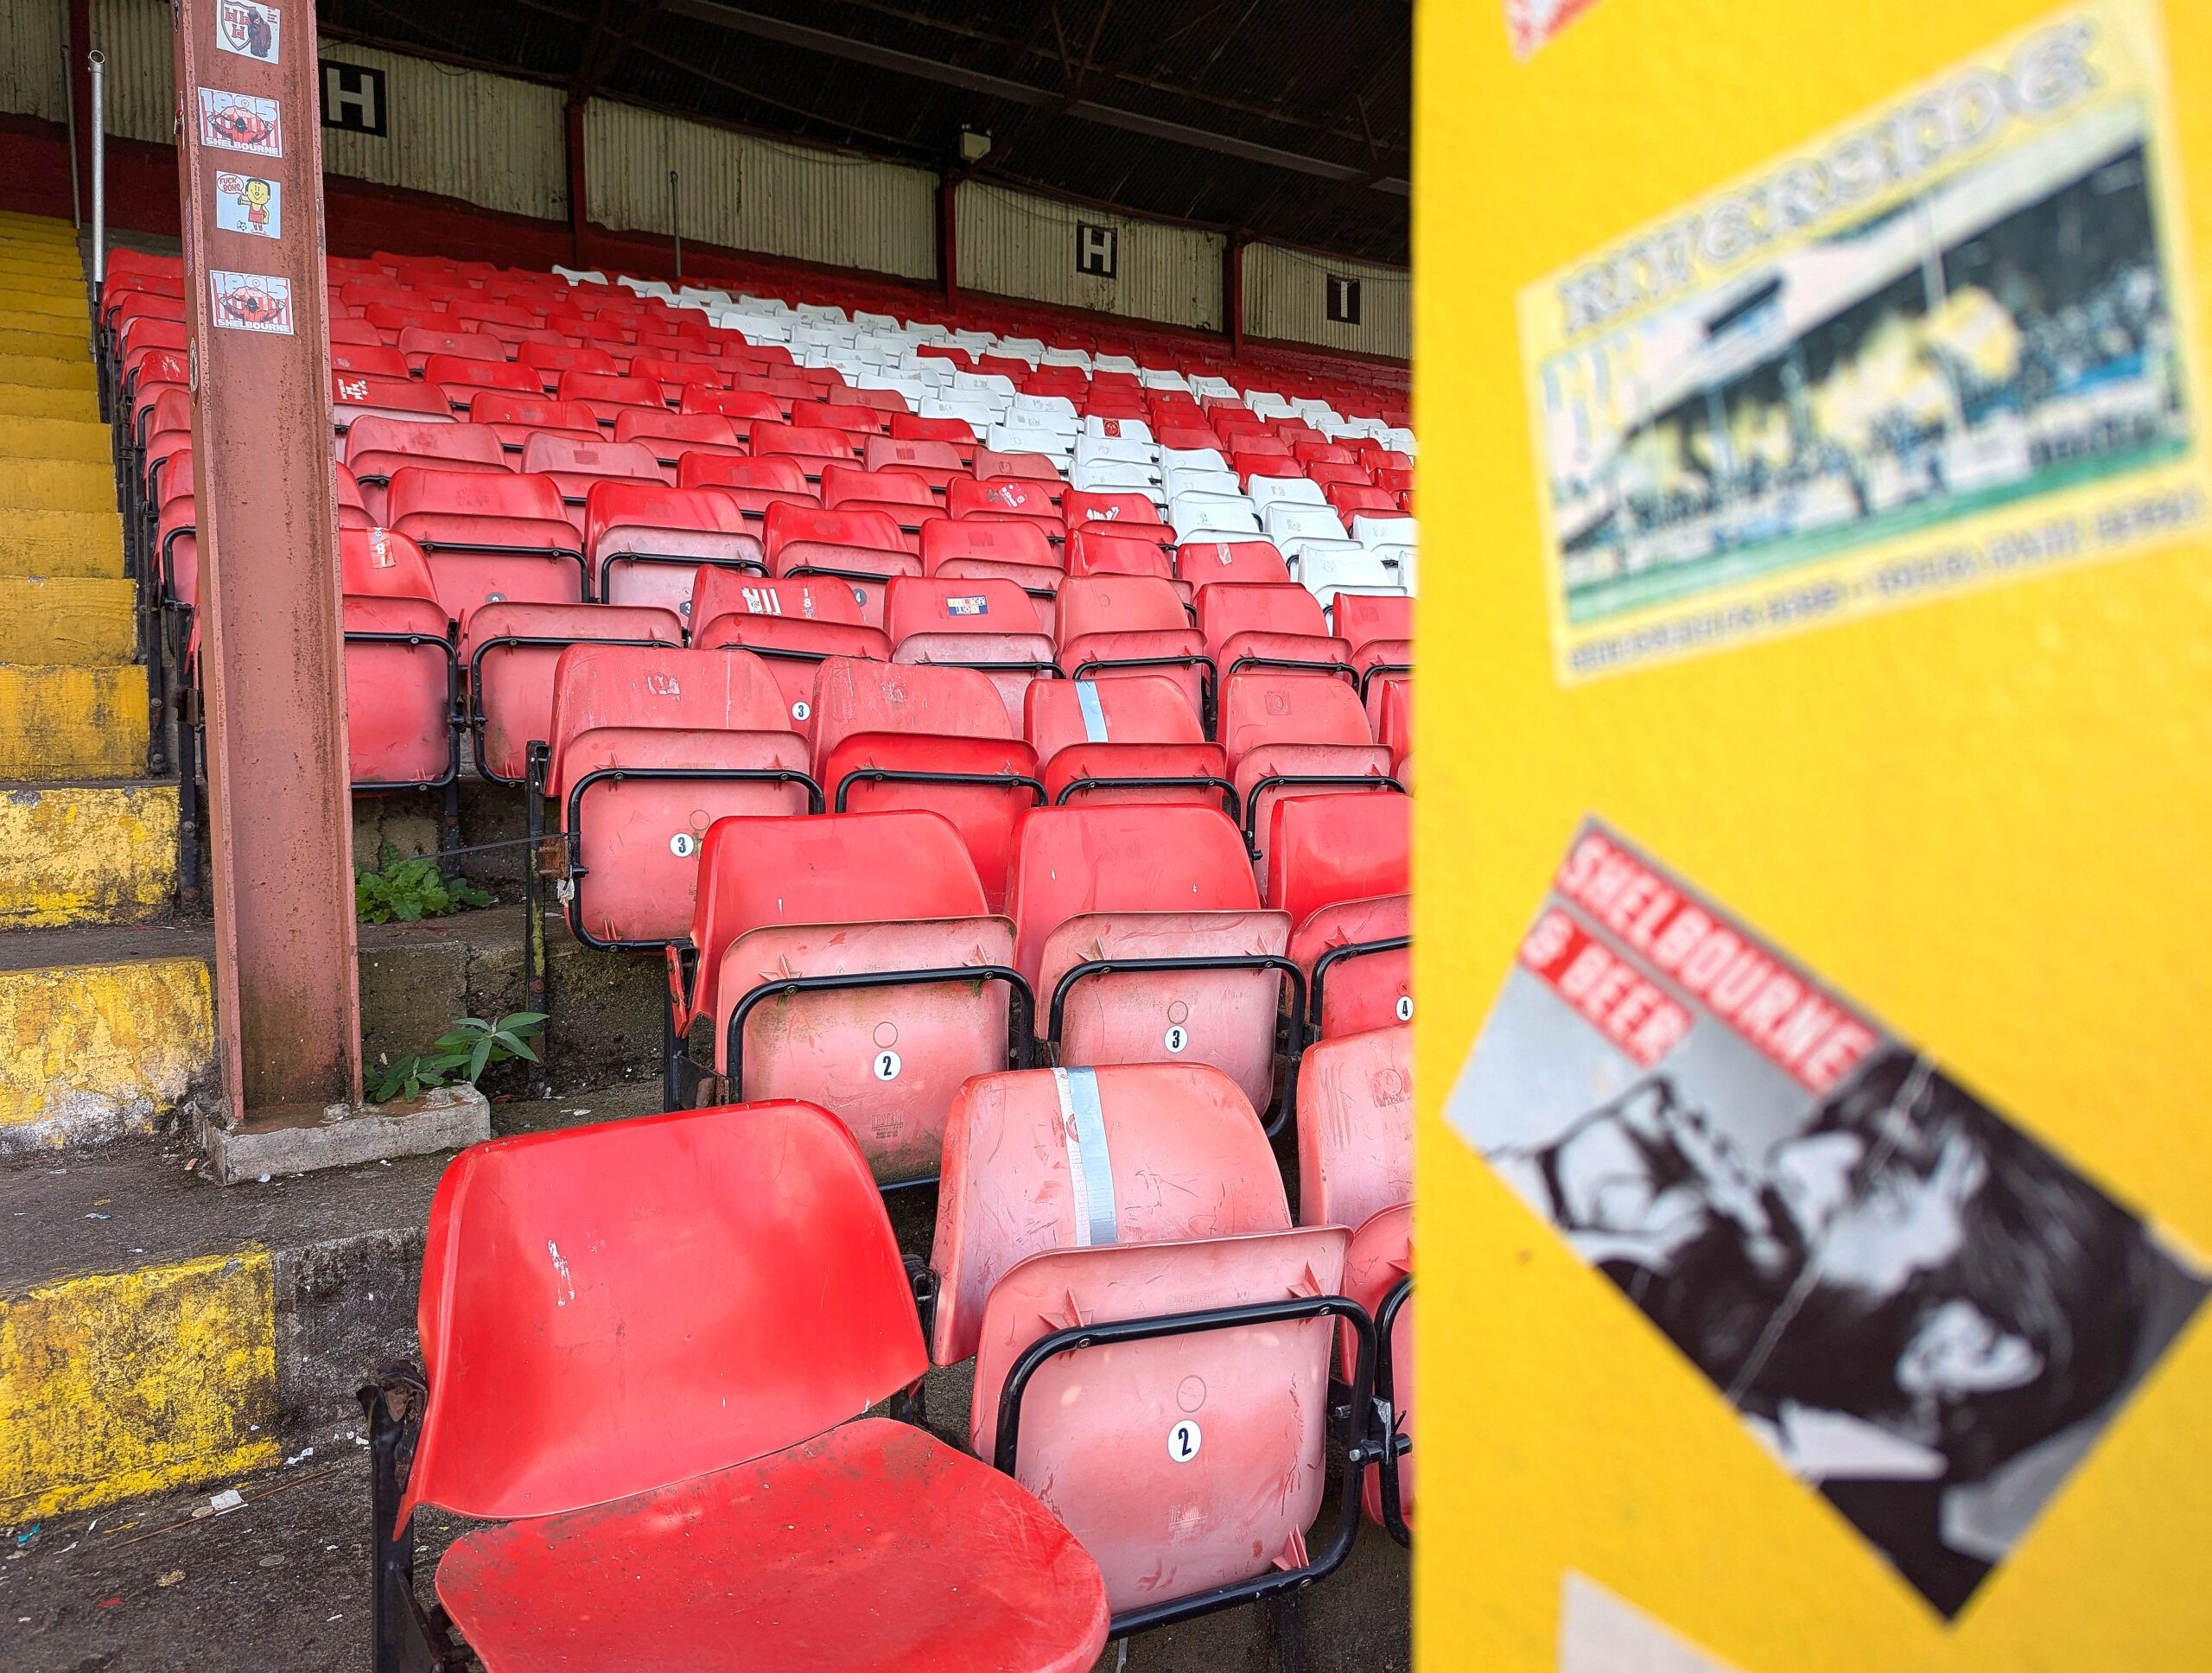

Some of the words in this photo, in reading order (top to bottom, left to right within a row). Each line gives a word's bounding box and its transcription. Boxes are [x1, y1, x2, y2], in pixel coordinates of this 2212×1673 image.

[327, 67, 375, 129] H
[205, 137, 279, 155] SHELBOURNE
[223, 183, 241, 192] BOHS
[1083, 226, 1112, 273] H
[1340, 281, 1348, 319] I
[216, 318, 290, 333] SHELBOURNE
[798, 704, 804, 718] 3
[677, 836, 687, 854] 3
[1558, 831, 1882, 1095] SHELBOURNE
[1402, 1000, 1408, 1016] 4
[1557, 942, 1690, 1066] BEER
[1172, 1029, 1180, 1049] 3
[882, 1055, 893, 1077] 2
[1178, 1427, 1192, 1457] 2
